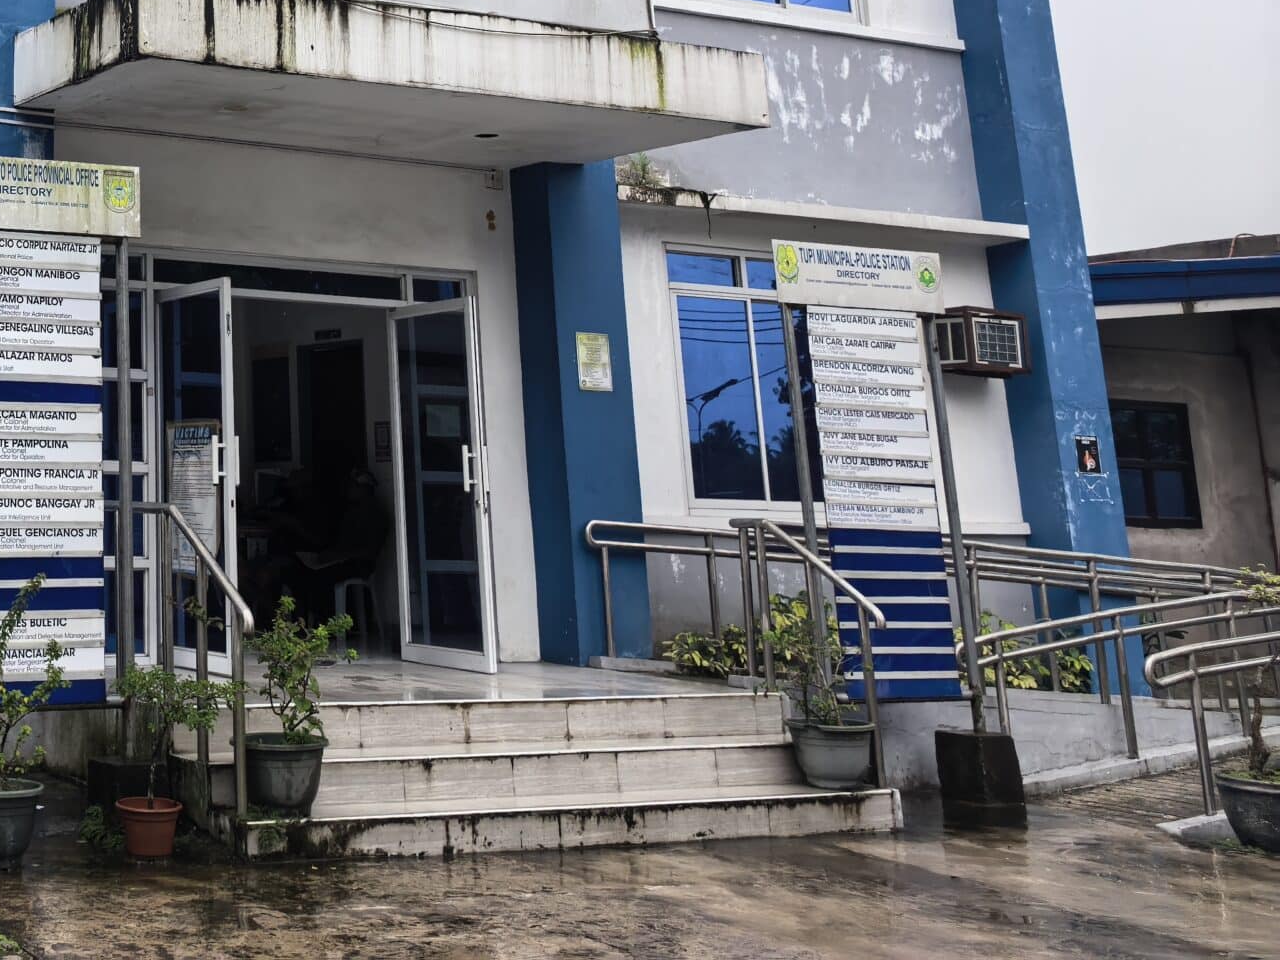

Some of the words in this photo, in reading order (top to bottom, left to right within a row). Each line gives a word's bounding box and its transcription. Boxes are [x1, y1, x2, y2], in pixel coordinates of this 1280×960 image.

[7, 163, 32, 182] POLICE
[34, 165, 74, 185] PROVINCIAL
[75, 168, 99, 187] OFFICE
[16, 240, 48, 250] CORPUZ
[50, 241, 87, 253] NARTATEZ
[88, 244, 98, 254] JR
[798, 248, 816, 264] TUPI
[881, 255, 912, 271] STATION
[35, 269, 81, 280] MANIBOG
[836, 270, 880, 280] DIRECTORY
[26, 296, 64, 306] NAPILOY
[56, 325, 94, 336] VILLEGAS
[37, 352, 73, 363] RAMOS
[814, 360, 850, 370] BRENDON
[852, 362, 889, 373] ALCORIZA
[890, 366, 914, 375] WONG
[29, 411, 77, 421] MAGANTO
[12, 439, 69, 449] PAMPOLINA
[44, 469, 85, 479] FRANCIA
[87, 469, 98, 479] JR
[35, 498, 81, 508] BANGGAY
[84, 499, 95, 508] JR
[25, 528, 84, 537] GENCIANOS
[86, 528, 98, 537] JR
[30, 618, 67, 627] BULETIC
